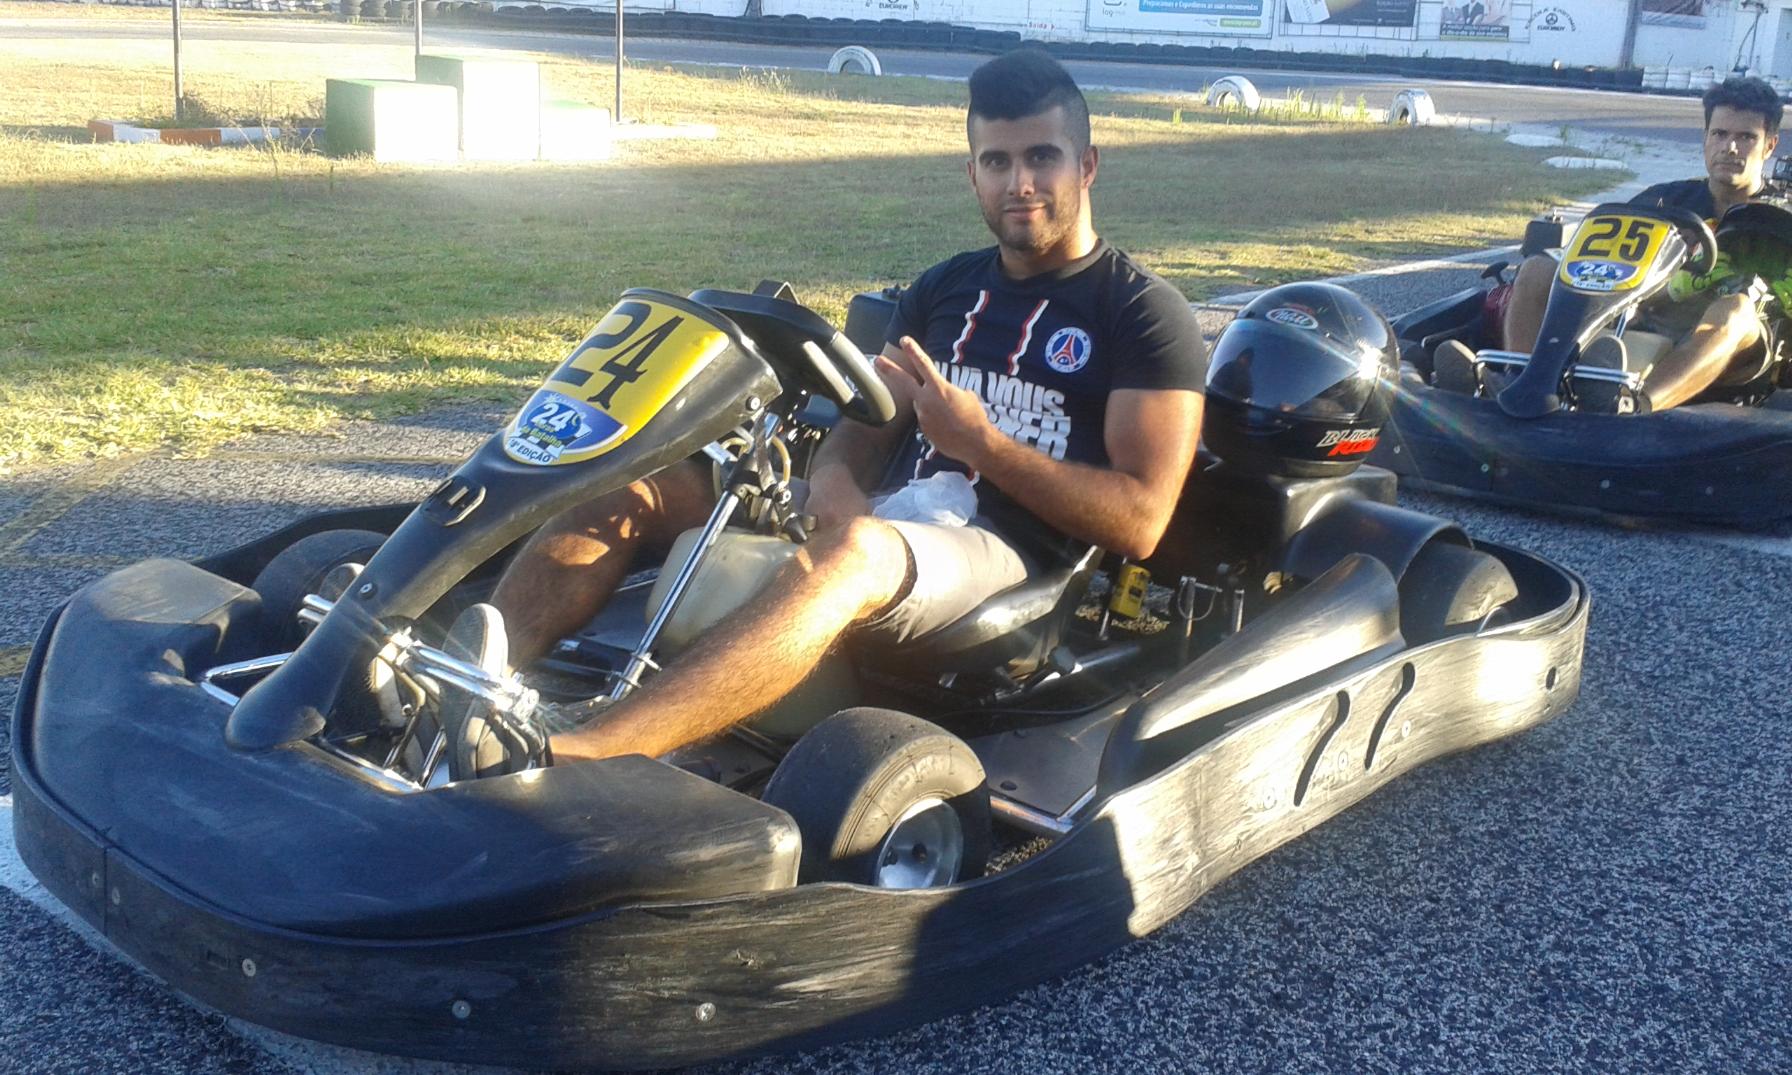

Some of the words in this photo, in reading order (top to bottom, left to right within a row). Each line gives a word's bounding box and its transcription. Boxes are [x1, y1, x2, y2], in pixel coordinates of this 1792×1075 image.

[1578, 217, 1654, 262] 25
[550, 301, 685, 410] 24
[987, 371, 1065, 417] VOUS
[531, 403, 577, 432] 24
